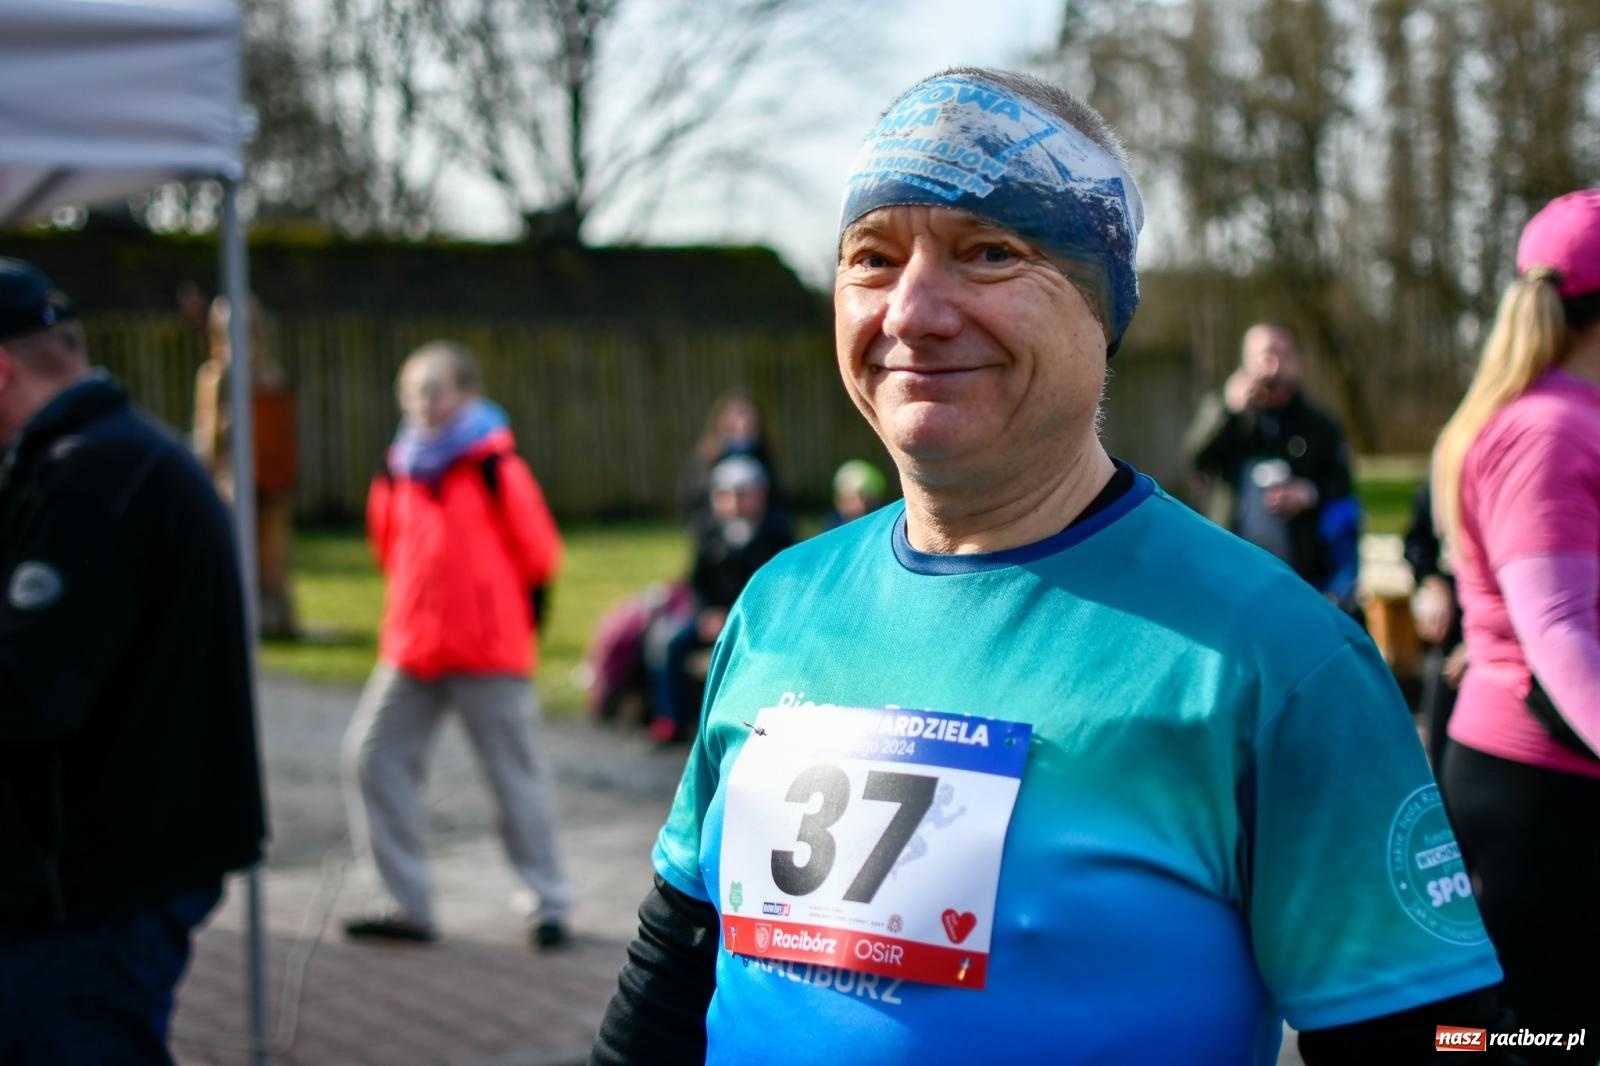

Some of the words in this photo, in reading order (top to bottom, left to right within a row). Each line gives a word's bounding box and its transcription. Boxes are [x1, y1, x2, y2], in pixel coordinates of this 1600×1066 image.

[881, 739, 916, 757] 2024
[771, 764, 939, 904] 37
[772, 928, 838, 955] Racibórz
[855, 938, 905, 967] OSiR
